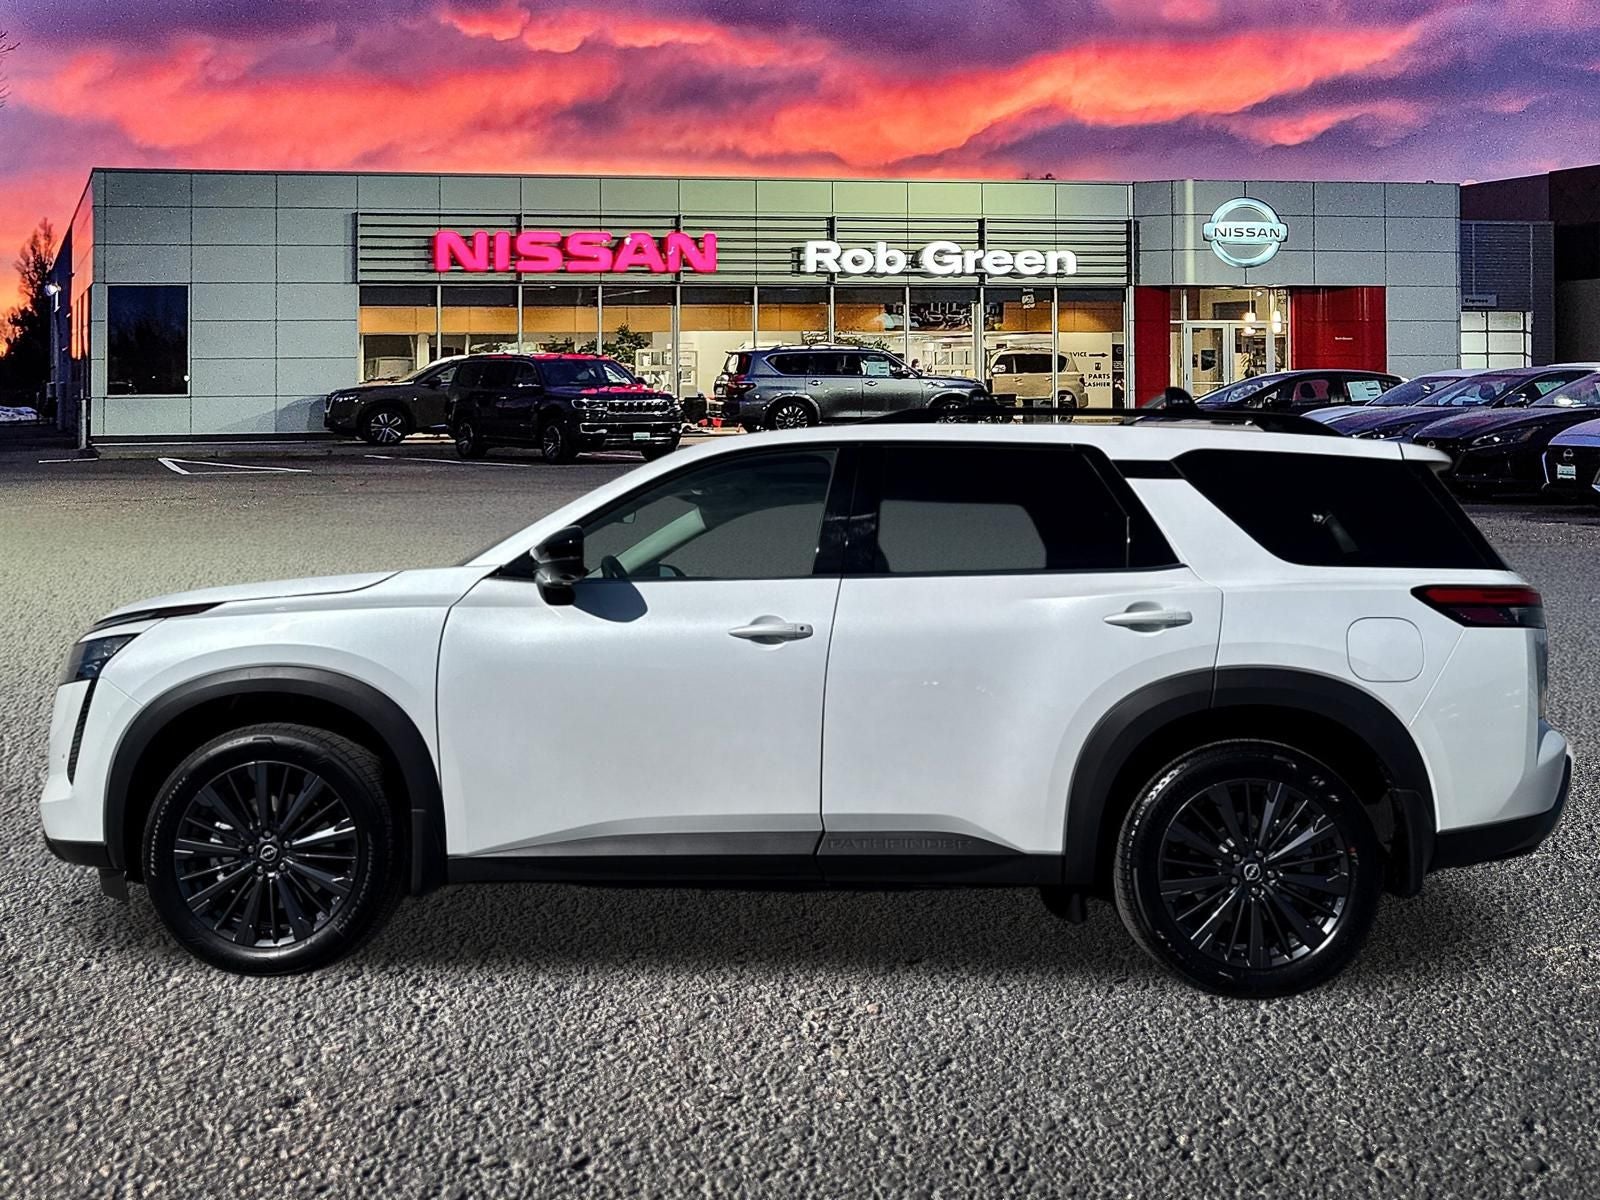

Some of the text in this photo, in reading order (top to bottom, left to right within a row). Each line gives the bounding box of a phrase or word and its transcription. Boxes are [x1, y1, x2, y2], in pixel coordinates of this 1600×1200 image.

[1214, 227, 1280, 238] NISSAN
[433, 231, 718, 273] NISSAN
[804, 240, 1078, 276] Rob Green
[828, 838, 972, 849] PATHFINDER
